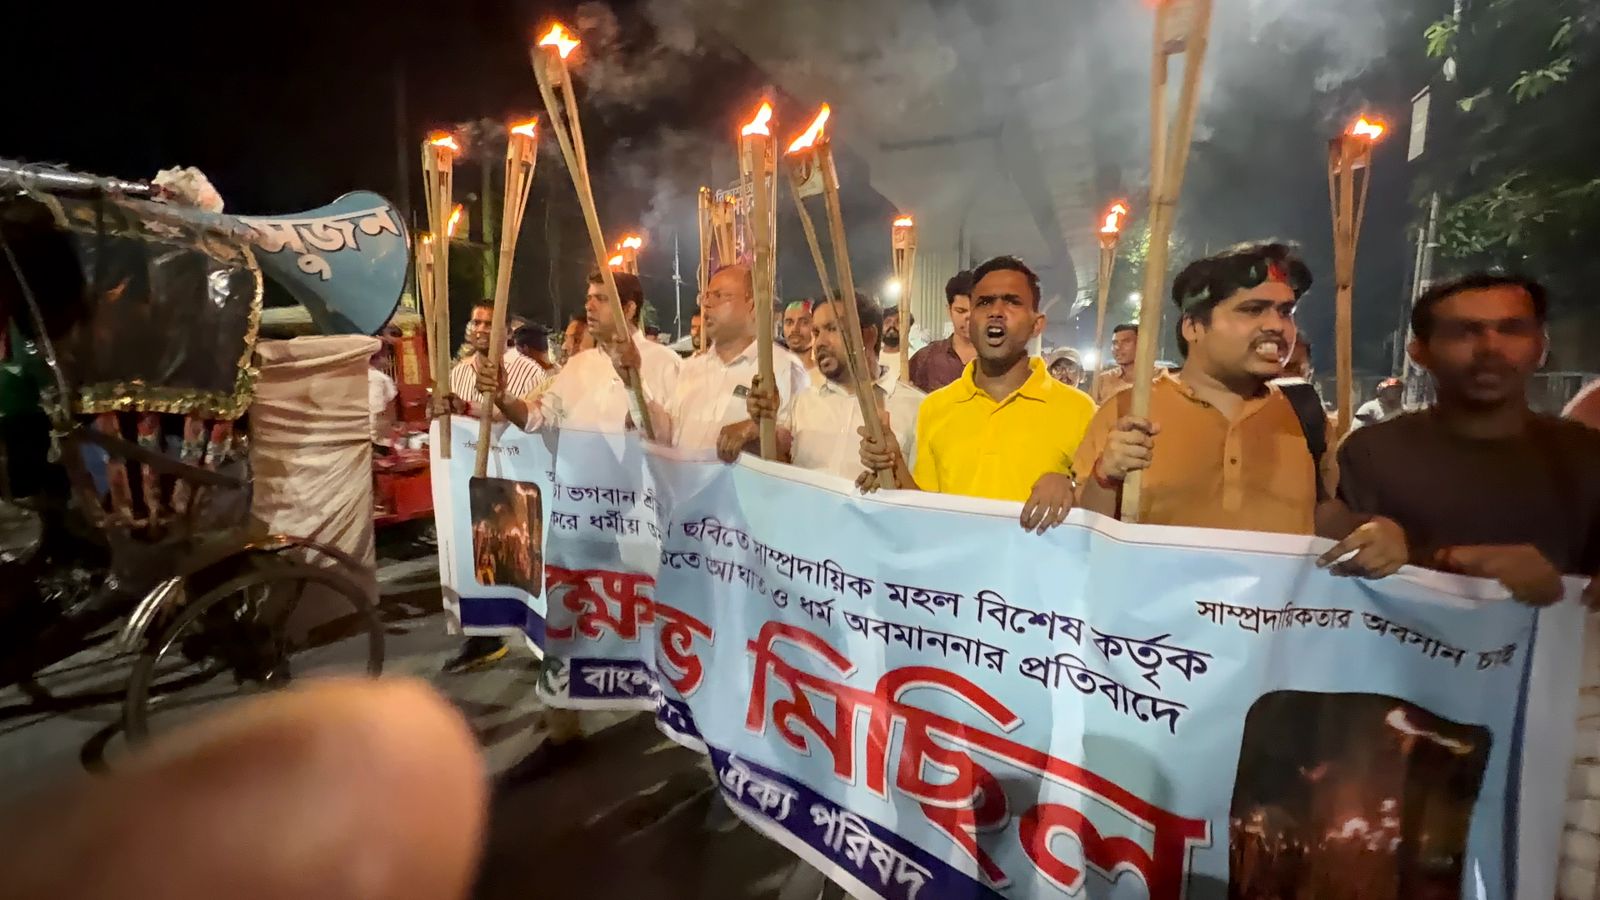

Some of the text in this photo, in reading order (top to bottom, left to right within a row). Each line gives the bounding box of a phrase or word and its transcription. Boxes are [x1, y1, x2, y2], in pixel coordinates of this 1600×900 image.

[566, 486, 637, 508] ভগবান
[590, 510, 641, 536] ধর্মীয়
[681, 516, 749, 550] ছবিতে
[884, 582, 964, 618] মহল
[974, 589, 1085, 646] বিশেষ
[1090, 626, 1214, 690] কর্তৃক
[1361, 612, 1467, 668] অবসান
[771, 588, 788, 609] ও
[800, 596, 836, 627] ধর্ম
[843, 610, 1010, 674] অবমাননার
[1019, 652, 1189, 735] প্রতিবাদে
[747, 622, 1212, 900] মিছিল
[809, 803, 933, 900] পরিষদ
